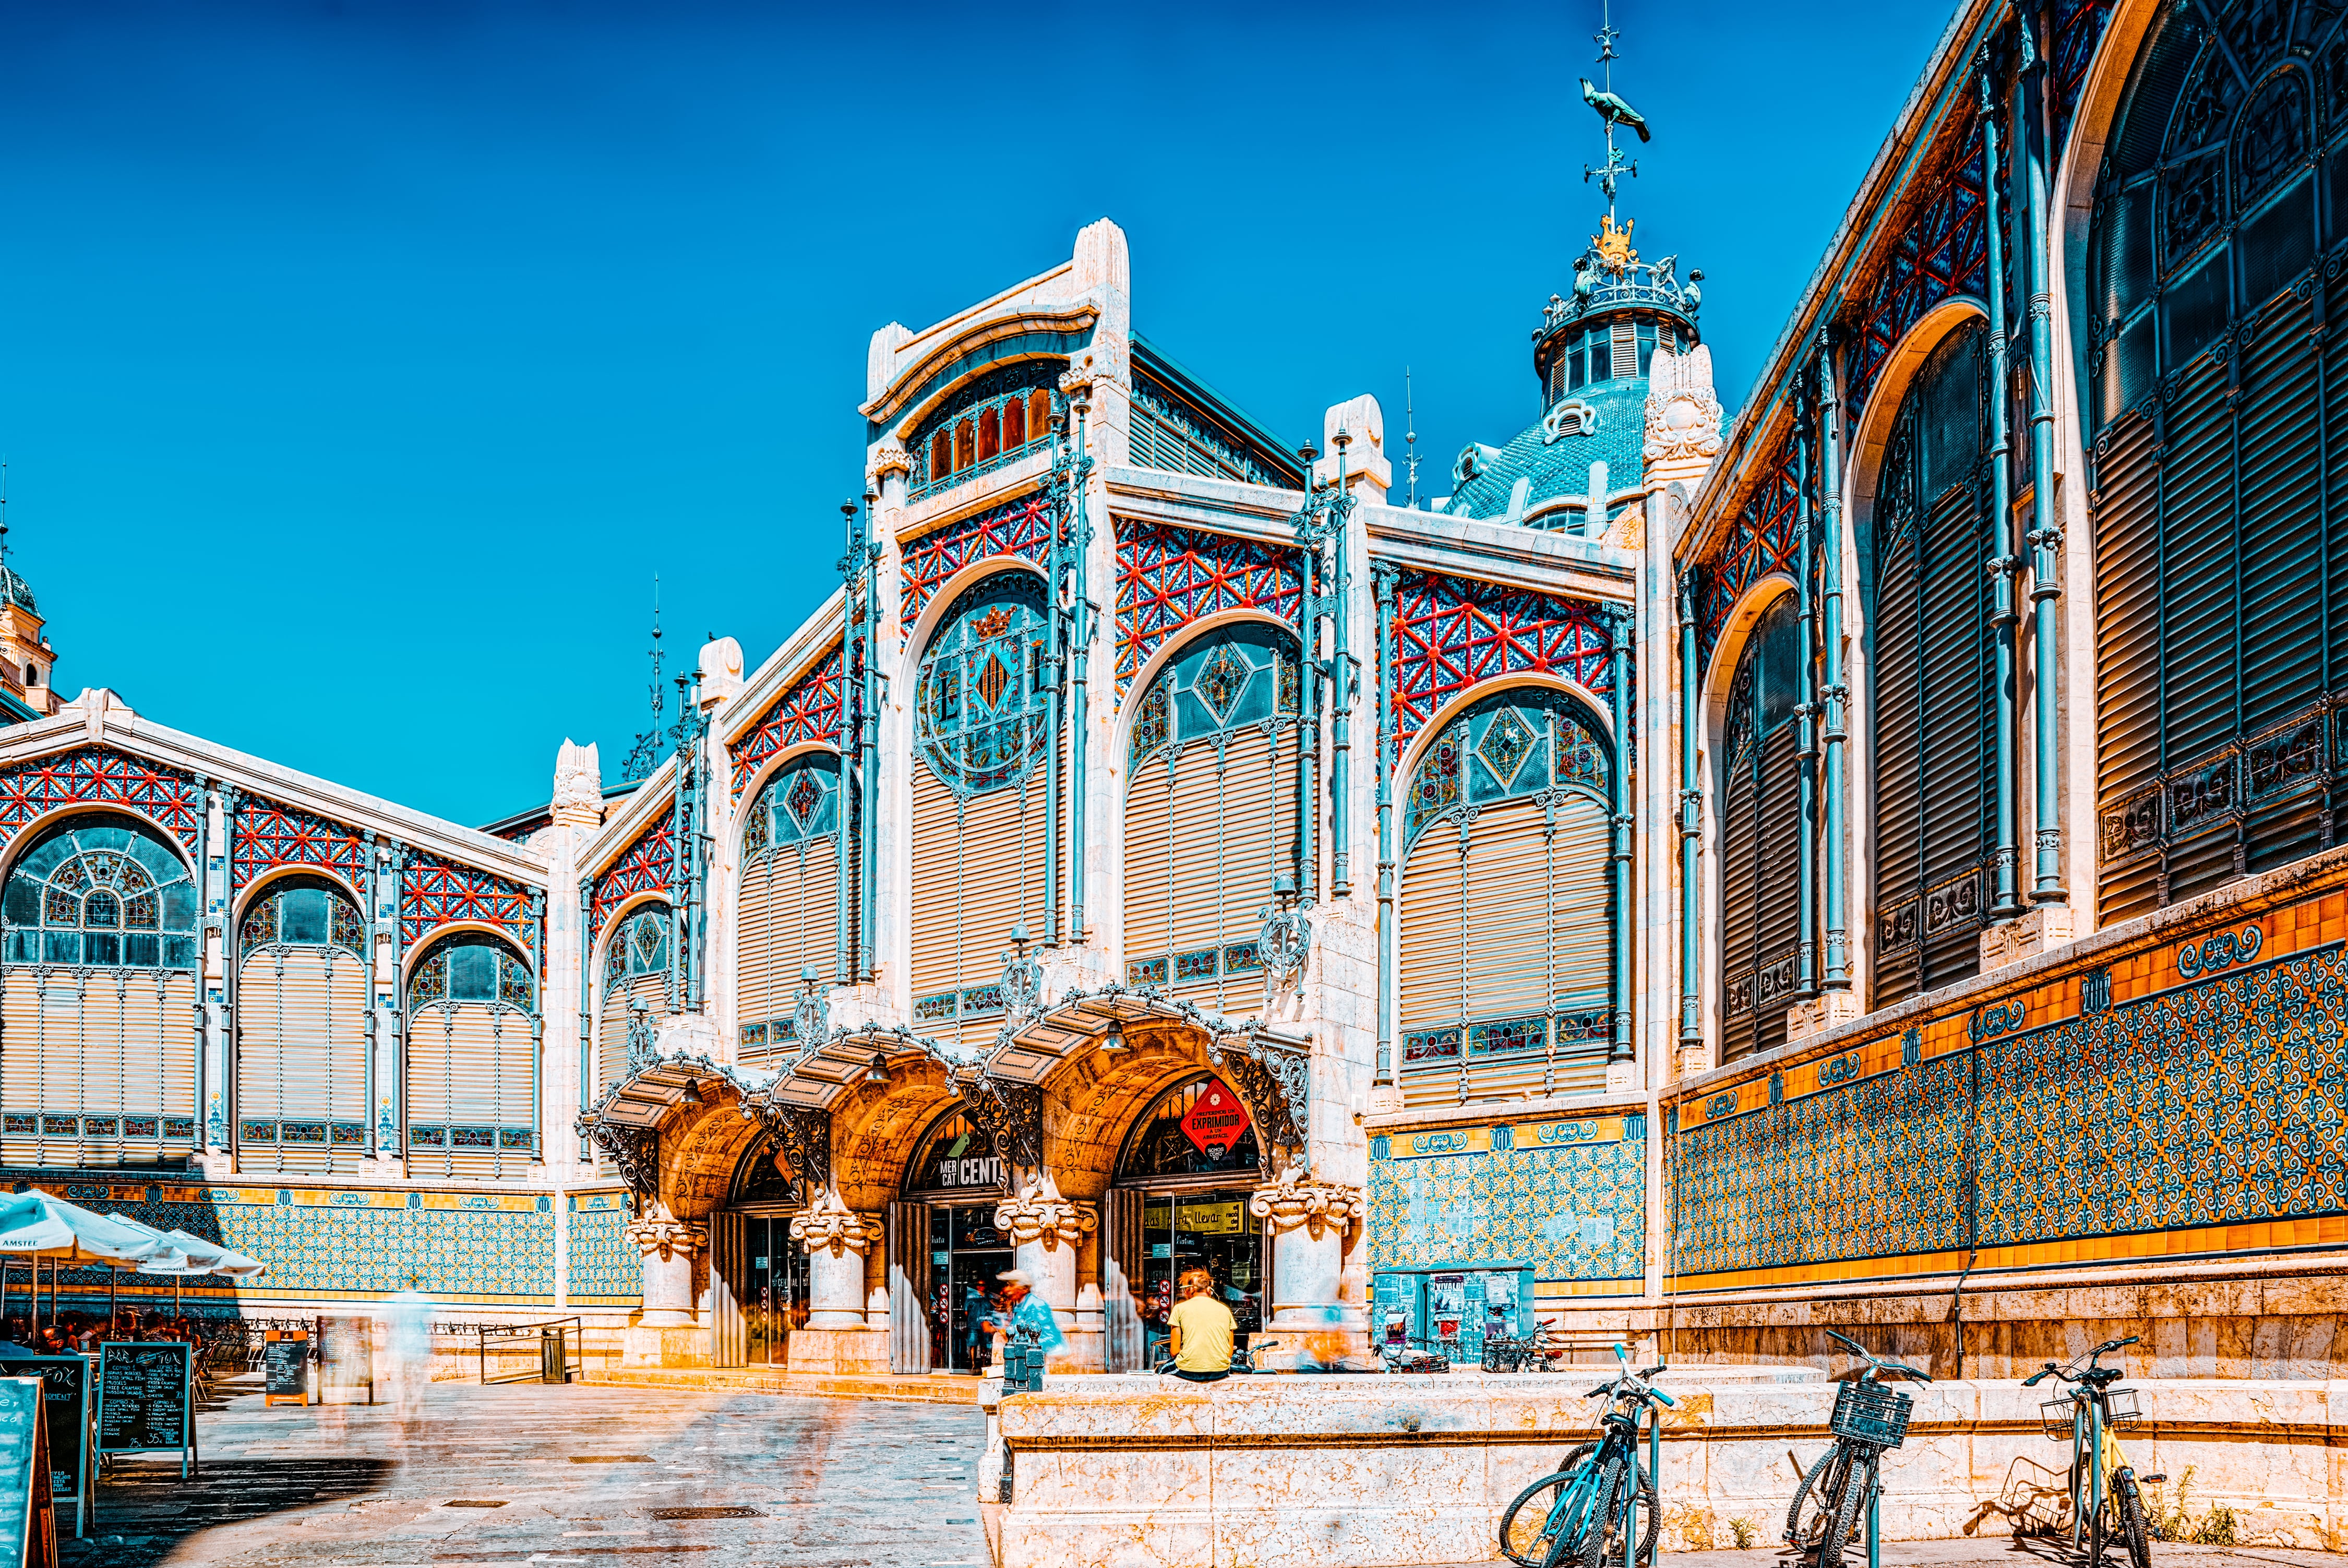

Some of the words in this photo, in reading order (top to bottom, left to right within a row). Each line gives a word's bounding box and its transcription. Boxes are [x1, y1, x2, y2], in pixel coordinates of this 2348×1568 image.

[1192, 1114, 1239, 1130] EXPRIMIDOR
[940, 1160, 956, 1174] MER
[942, 1173, 956, 1186] CAT
[1144, 1215, 1159, 1226] das
[1195, 1212, 1220, 1224] llevar
[931, 1235, 945, 1243] hata
[156, 1351, 181, 1364] FOX
[41, 1366, 76, 1386] FOX
